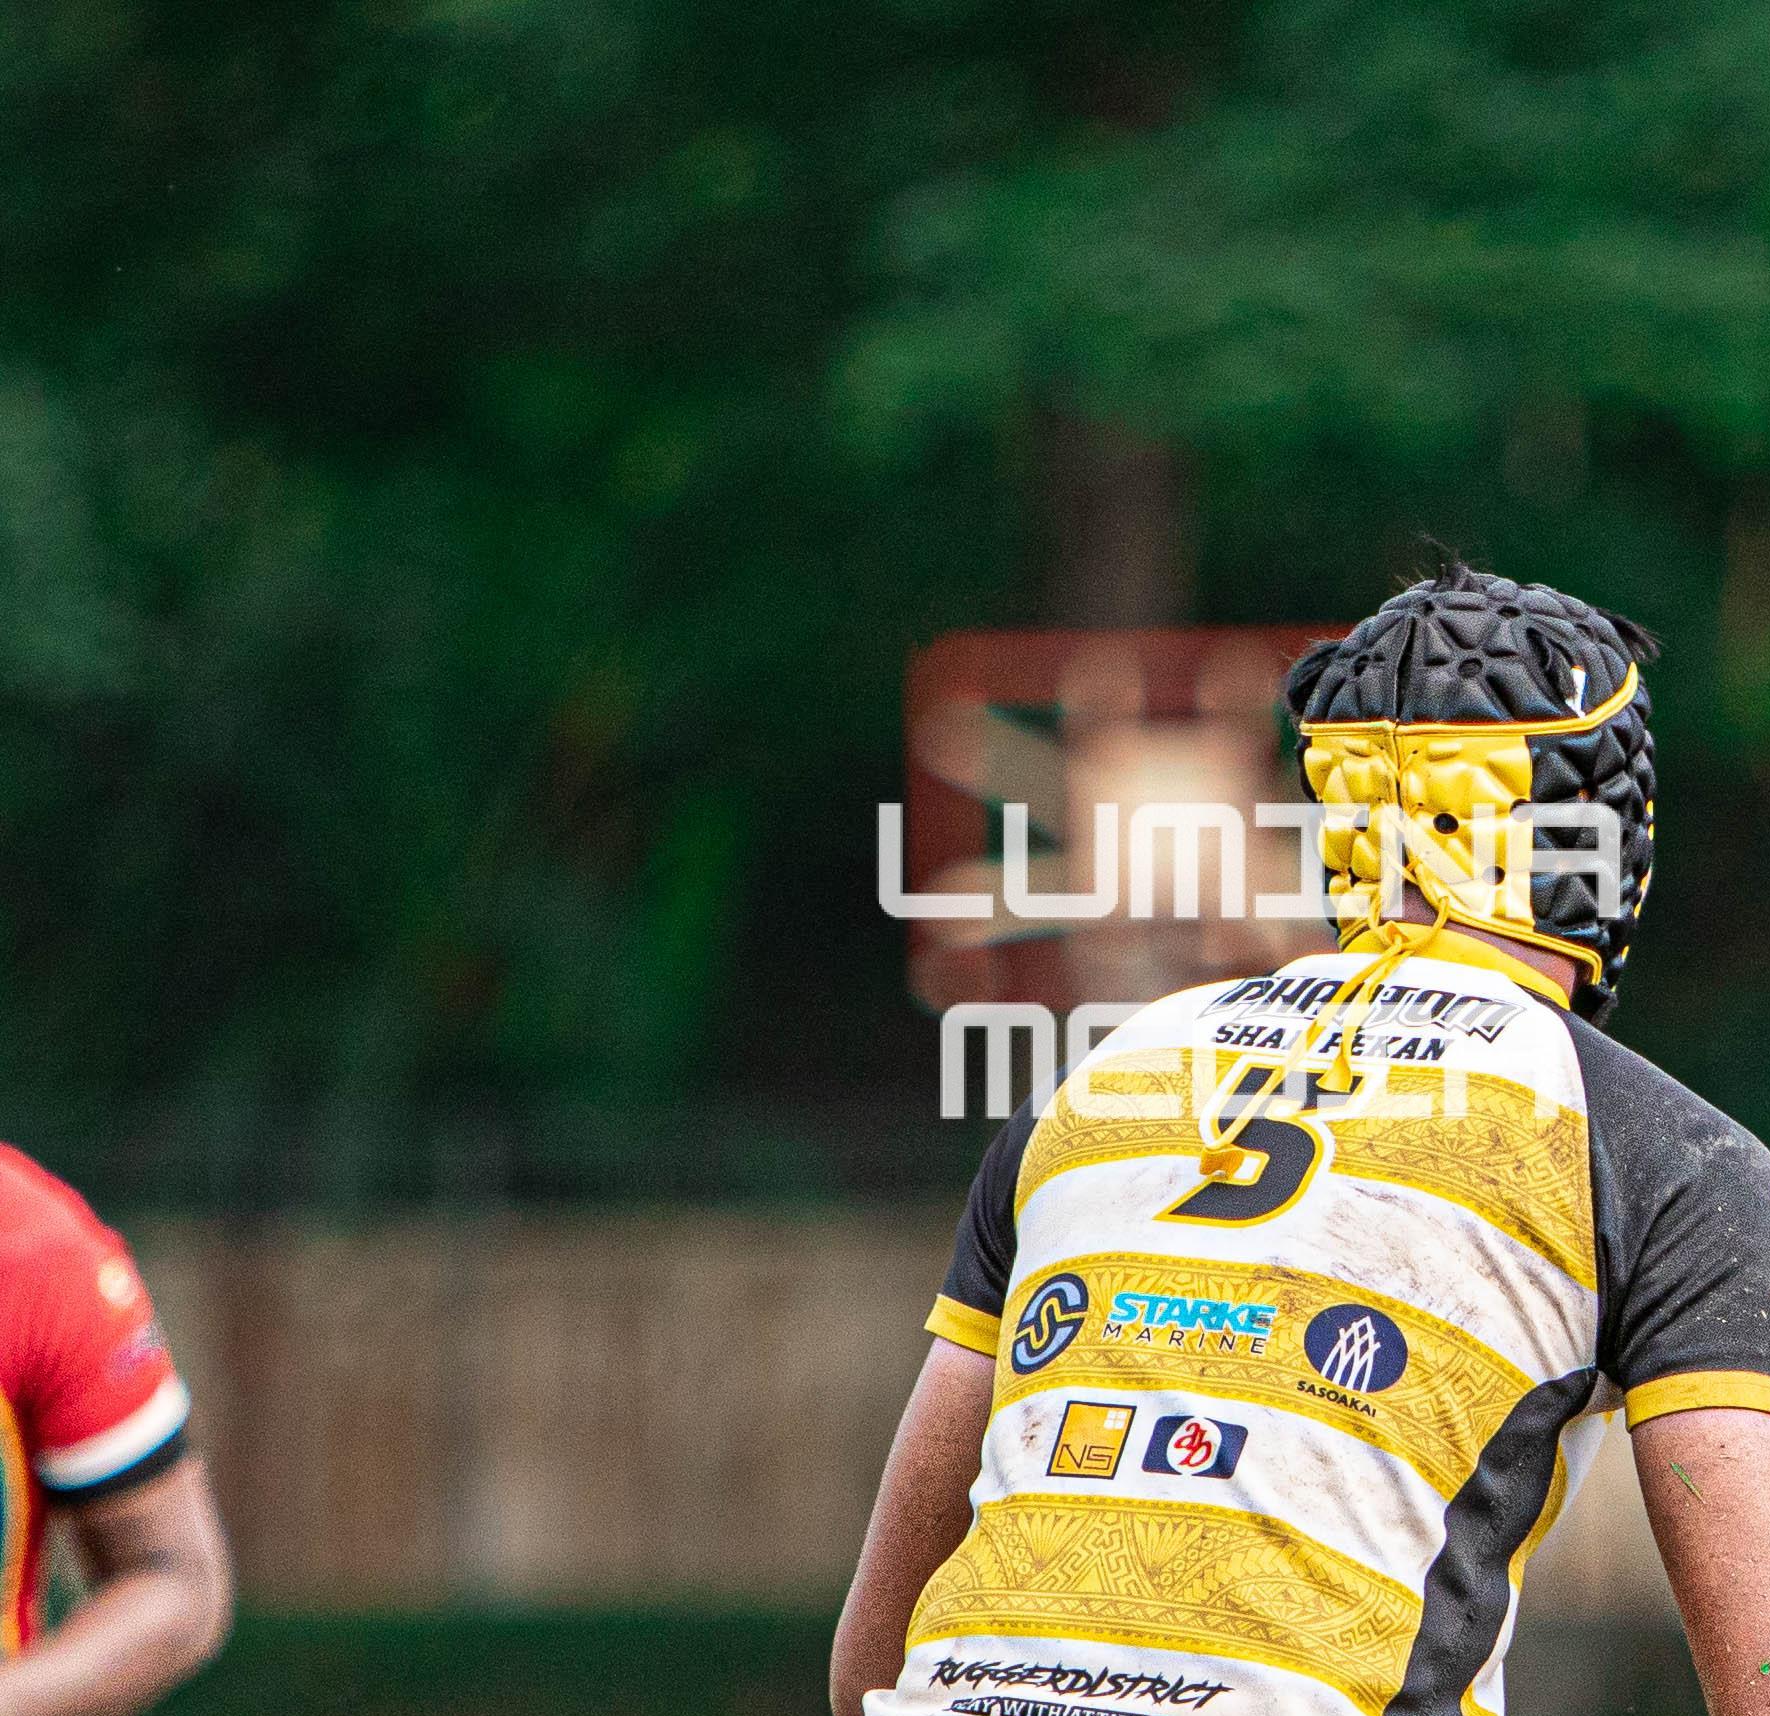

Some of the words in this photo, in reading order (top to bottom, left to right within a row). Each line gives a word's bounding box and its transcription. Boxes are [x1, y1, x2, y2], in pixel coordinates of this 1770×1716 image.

[1160, 1064, 1368, 1225] 5
[1107, 1291, 1277, 1337] STARKE
[1102, 1323, 1267, 1355] MARINE
[1296, 1380, 1377, 1418] SASOAKAI
[928, 1656, 1236, 1711] RUGGERDISTRICT
